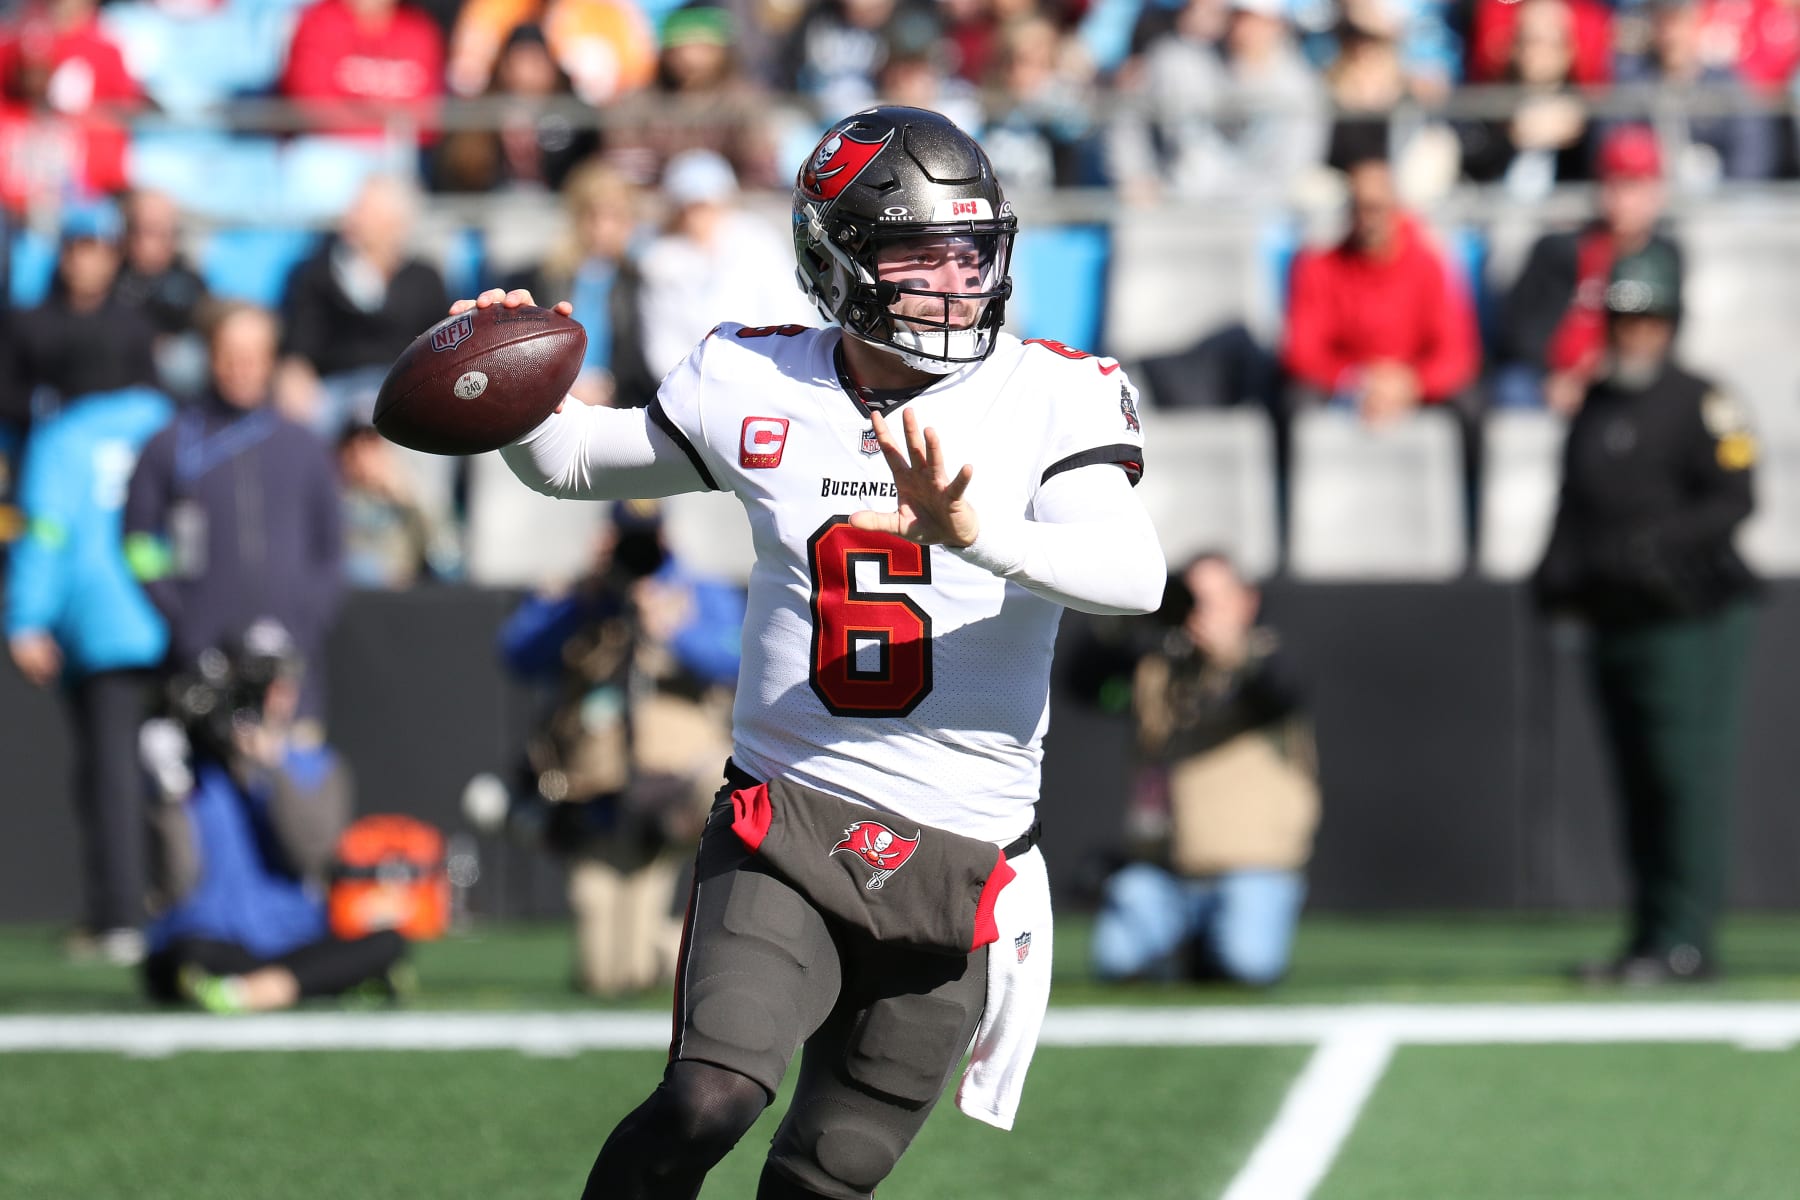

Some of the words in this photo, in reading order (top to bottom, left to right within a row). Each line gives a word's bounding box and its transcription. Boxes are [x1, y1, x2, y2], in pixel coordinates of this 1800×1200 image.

[434, 322, 469, 348] NFL
[464, 380, 481, 396] 240
[744, 420, 785, 455] C
[821, 477, 898, 501] BUCCANEE
[807, 514, 934, 719] 6
